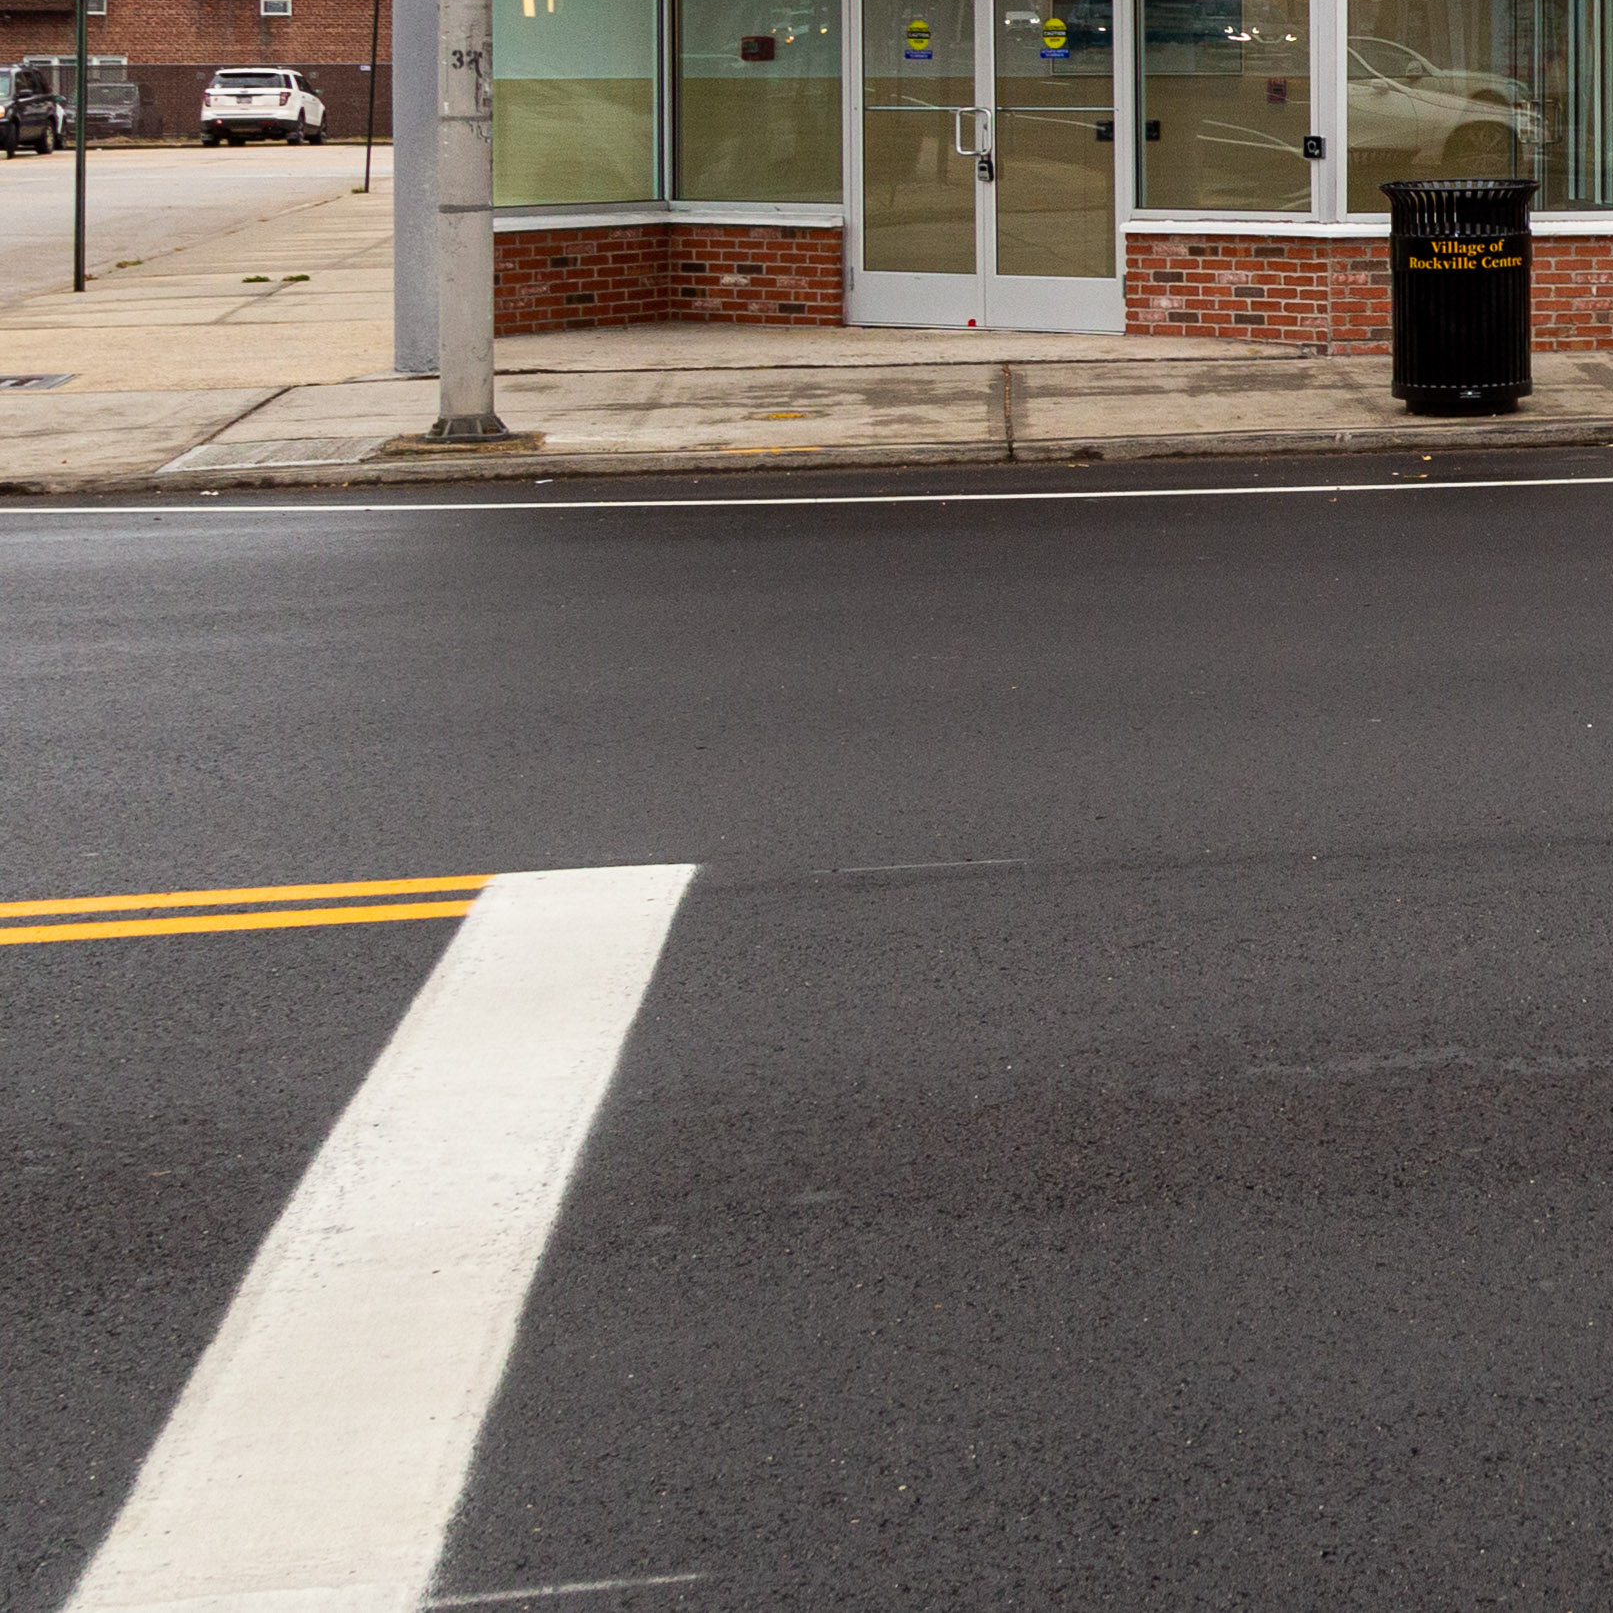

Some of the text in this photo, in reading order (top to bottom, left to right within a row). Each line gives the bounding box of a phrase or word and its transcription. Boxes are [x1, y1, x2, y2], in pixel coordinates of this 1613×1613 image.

[1431, 238, 1505, 256] Village of
[1409, 256, 1522, 269] Rockville Centre
